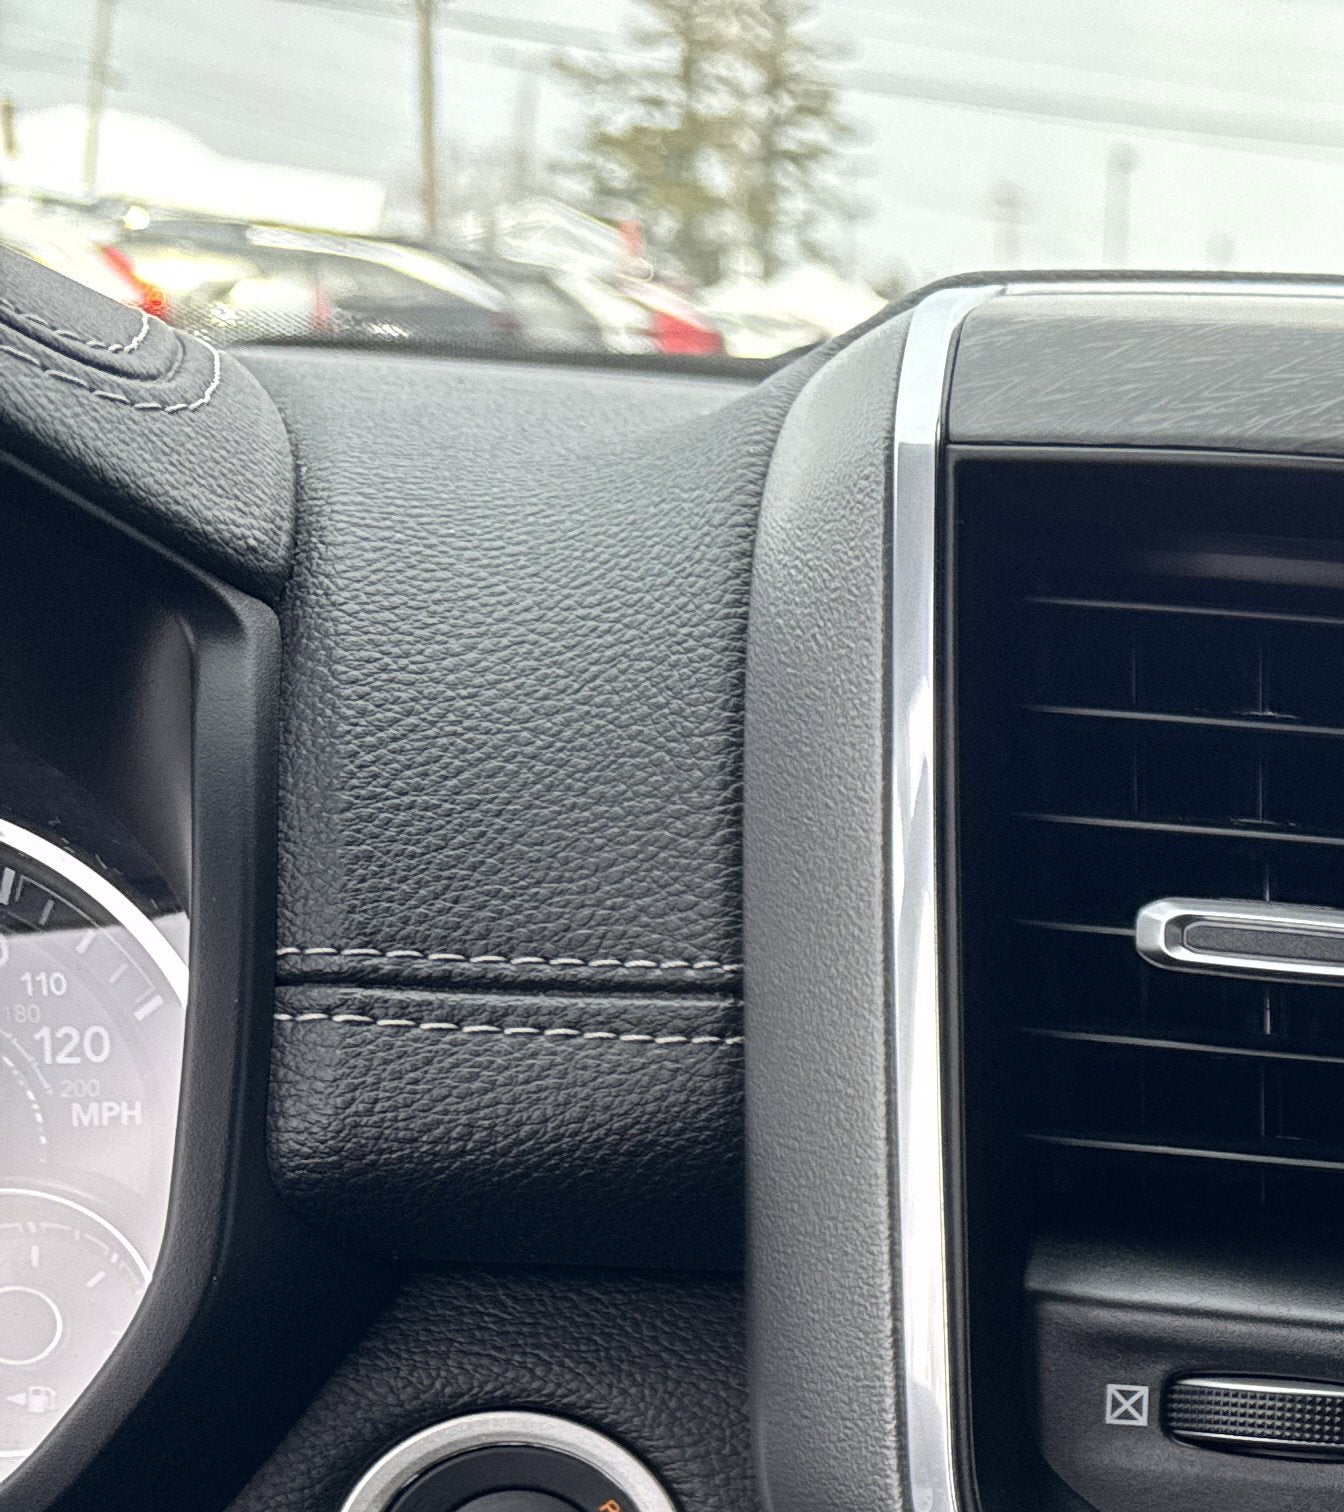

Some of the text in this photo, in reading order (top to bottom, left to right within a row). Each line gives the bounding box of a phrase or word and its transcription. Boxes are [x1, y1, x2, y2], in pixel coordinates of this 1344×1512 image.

[20, 971, 67, 996] 110
[33, 1025, 111, 1064] 120
[71, 1101, 142, 1127] MPH
